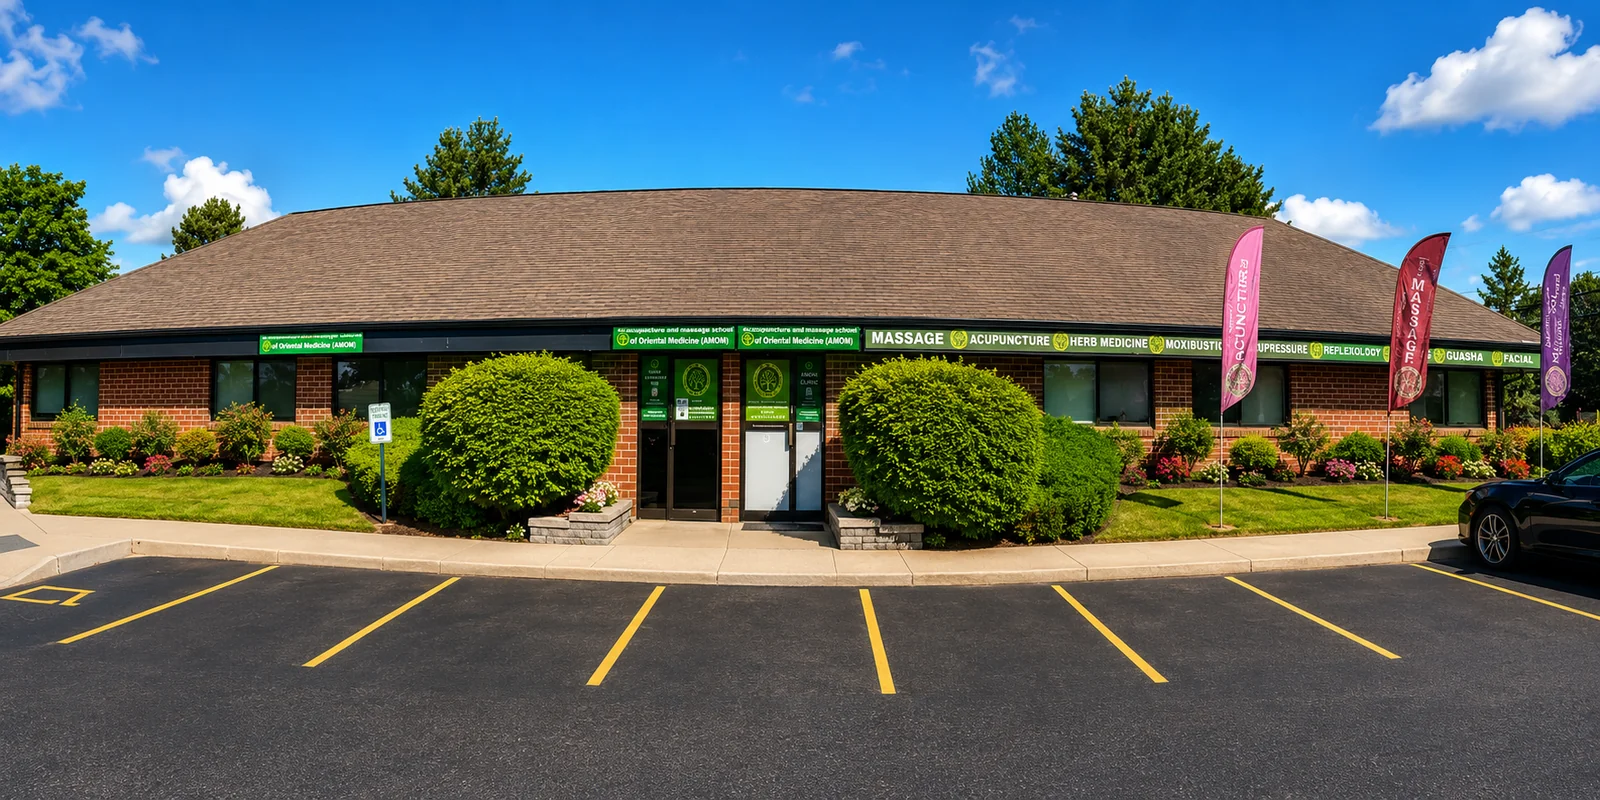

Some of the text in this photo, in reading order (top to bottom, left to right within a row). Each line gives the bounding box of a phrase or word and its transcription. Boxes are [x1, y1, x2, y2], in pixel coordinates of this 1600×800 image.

[303, 341, 330, 349] Medicine
[630, 336, 729, 345] of Oriental Medicine (AMOM)
[763, 336, 791, 344] Oriental
[792, 336, 824, 344] Medicine
[825, 336, 853, 346] (AMOM)
[871, 331, 944, 345] MASSAGE
[969, 334, 1050, 346] ACUPUNCTURE
[1070, 336, 1097, 347] HERB
[1100, 337, 1148, 349] MEDICINE
[1446, 350, 1483, 362] GUASHA
[1503, 354, 1534, 364] FACIAL
